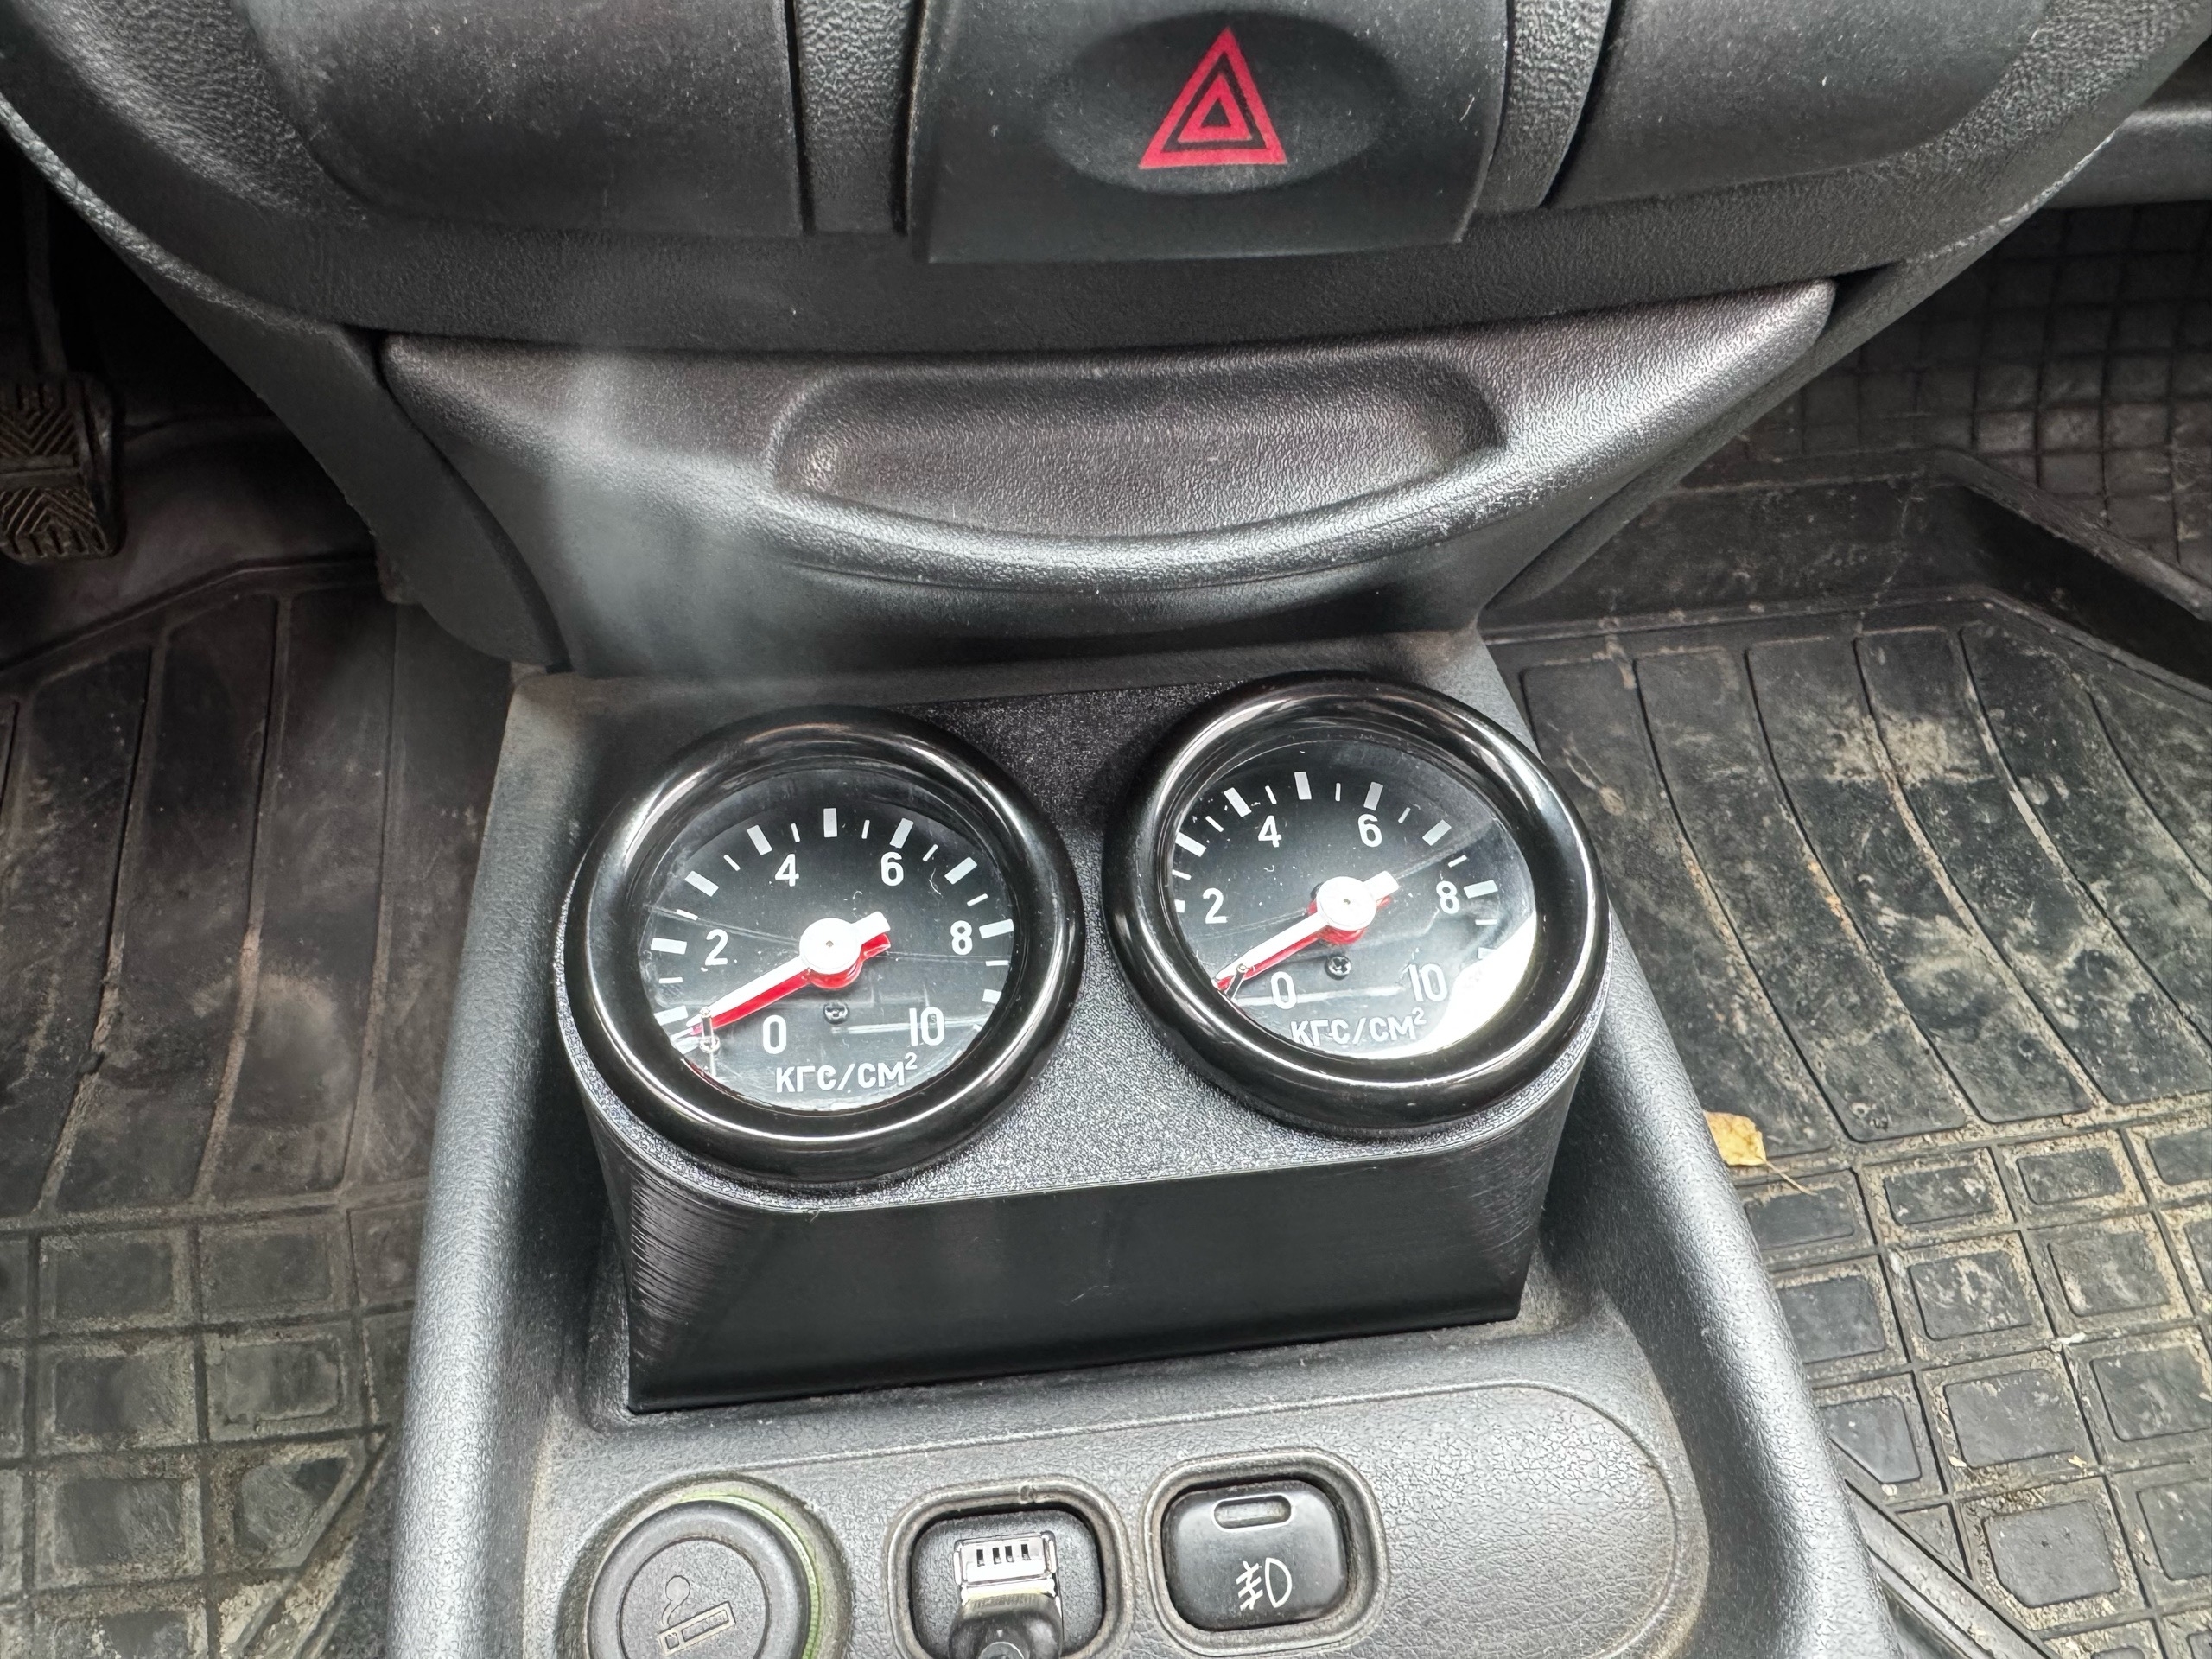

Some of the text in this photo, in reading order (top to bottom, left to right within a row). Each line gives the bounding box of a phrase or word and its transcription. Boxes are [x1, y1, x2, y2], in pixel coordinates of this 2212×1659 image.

[1258, 816, 1281, 848] 4
[1358, 814, 1382, 848] 6
[775, 854, 799, 887] 4
[880, 852, 904, 886] 6
[1203, 888, 1227, 924] 2
[1436, 880, 1459, 914] 8
[705, 929, 728, 966] 2
[950, 921, 973, 955] 8
[1271, 972, 1296, 1009] 0
[1408, 963, 1447, 1002] 10
[762, 1015, 787, 1054] 0
[909, 1007, 944, 1046] 10
